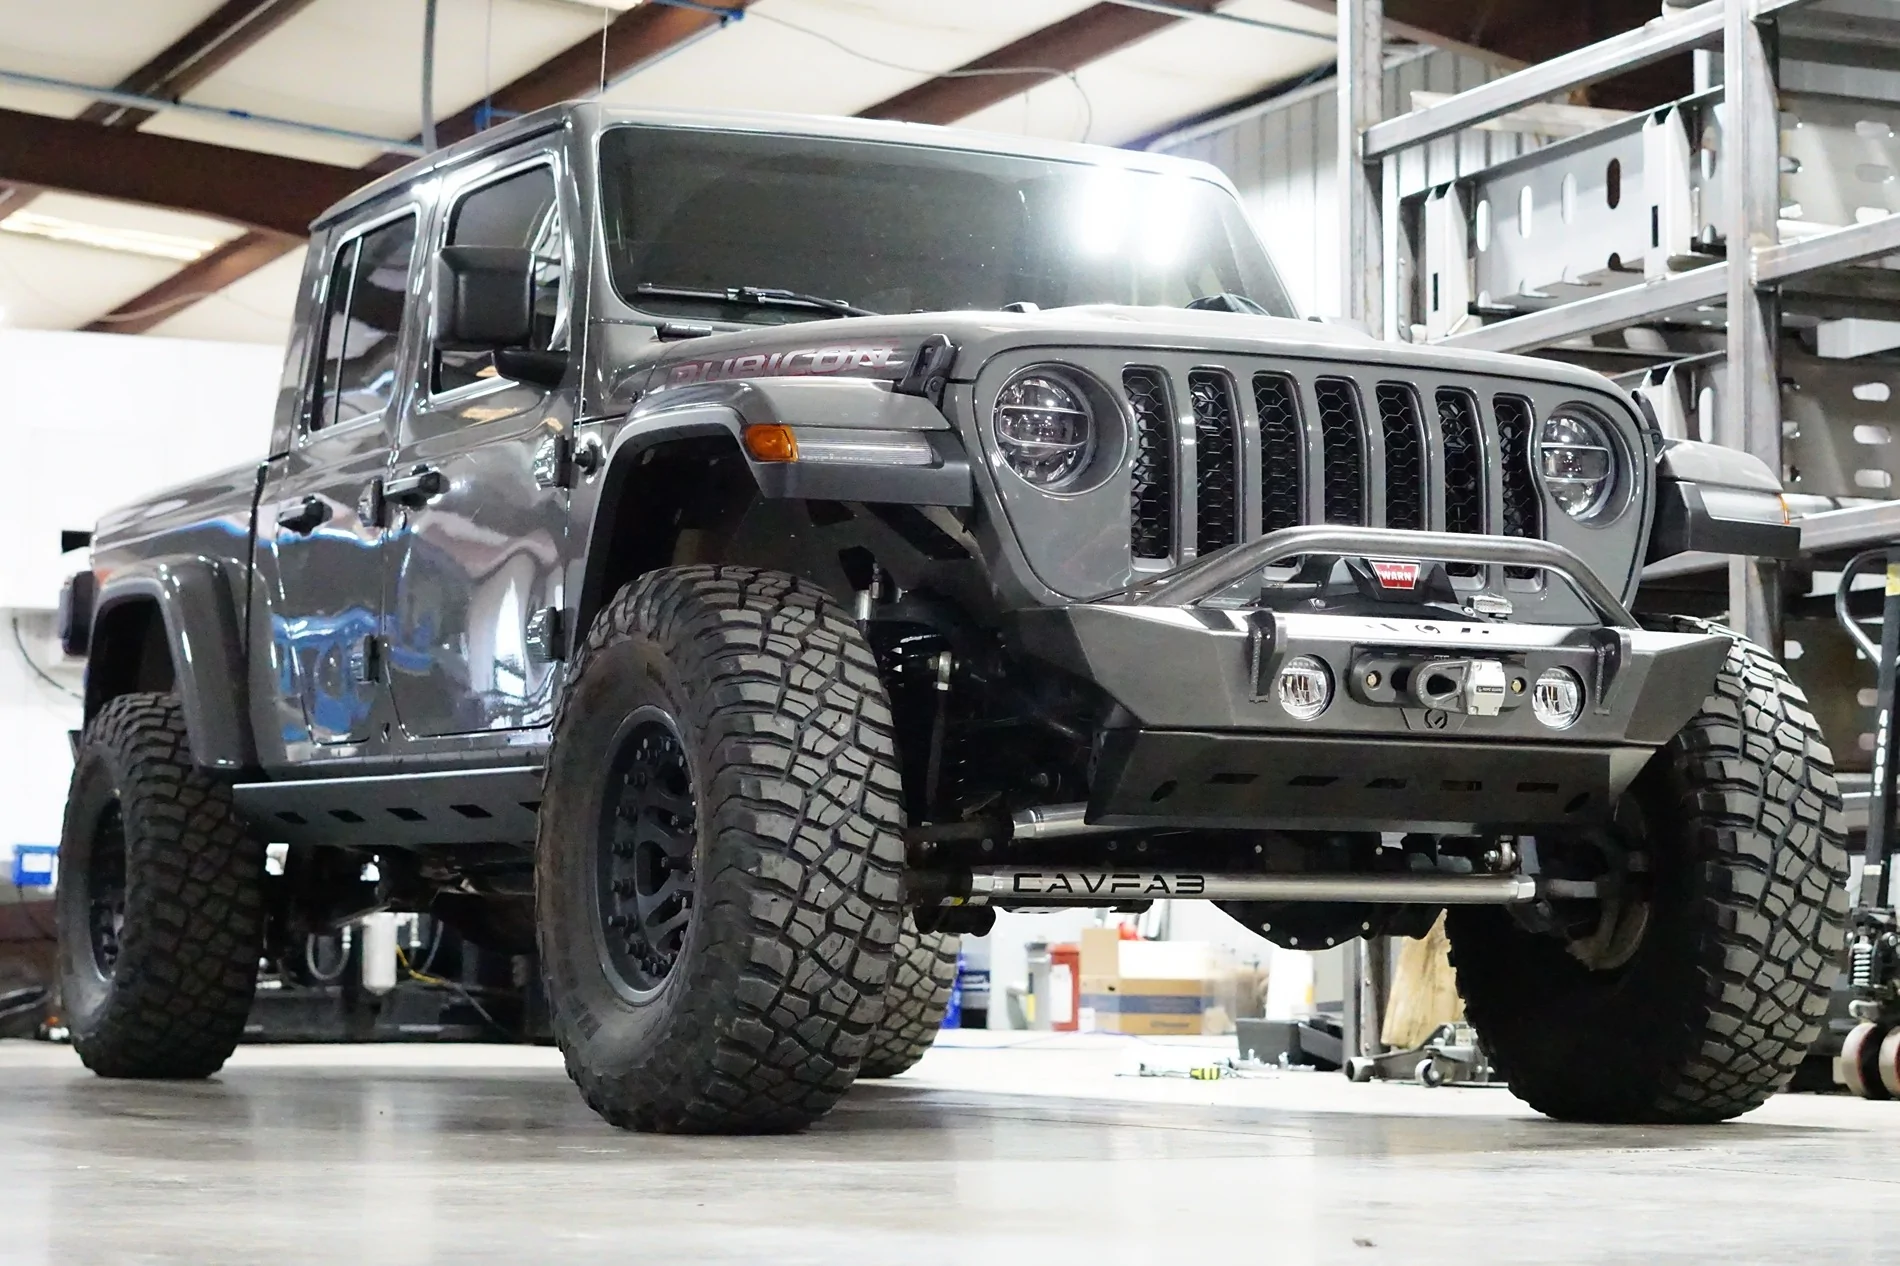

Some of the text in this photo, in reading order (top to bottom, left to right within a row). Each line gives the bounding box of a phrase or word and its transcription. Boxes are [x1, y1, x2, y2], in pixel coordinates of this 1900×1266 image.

[666, 342, 898, 388] RUBICON
[1381, 571, 1412, 581] WARN
[1013, 872, 1205, 894] CAVFAB
